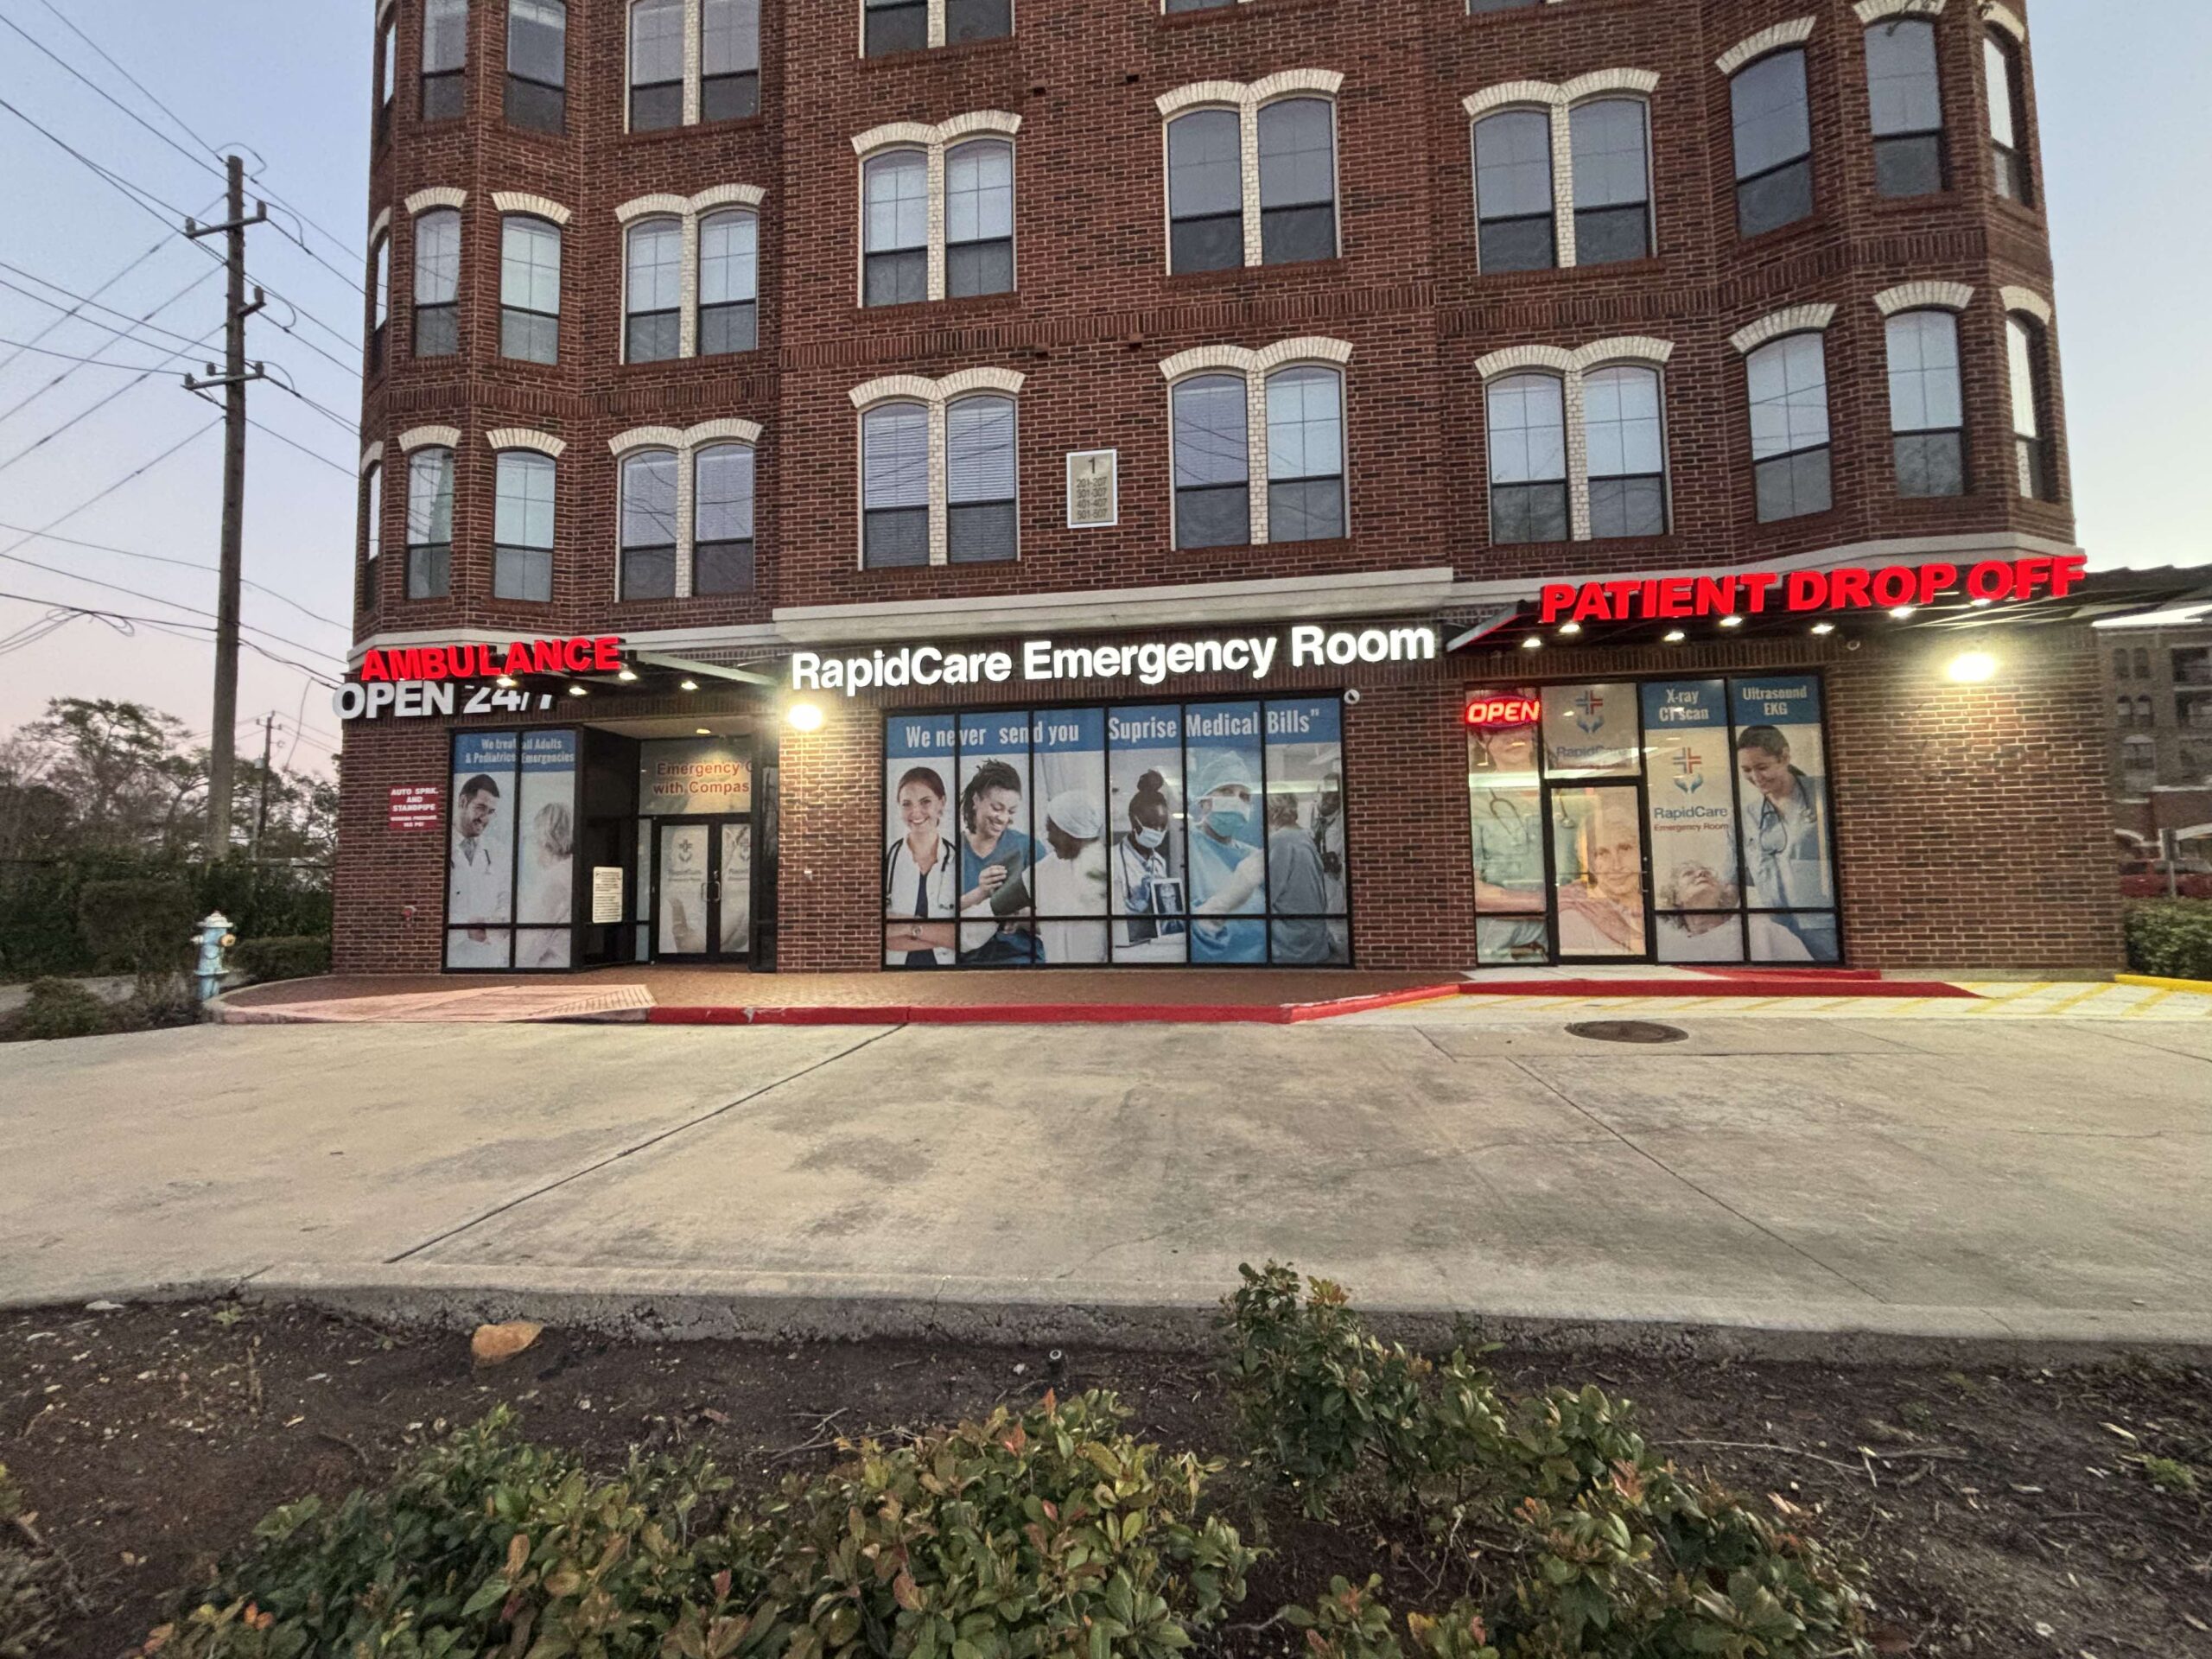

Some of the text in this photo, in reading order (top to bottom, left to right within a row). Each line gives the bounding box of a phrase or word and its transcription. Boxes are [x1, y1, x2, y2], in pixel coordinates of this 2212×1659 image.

[1088, 456, 1095, 474] 1
[1539, 556, 2088, 623] PATIENT DROP OFF
[360, 636, 621, 682] AMBULANCE
[791, 625, 1436, 697] RapidCare Emergency Room
[332, 680, 454, 720] OPEN
[1665, 688, 1700, 704] X-ray
[1743, 686, 1808, 700] Ultrasound
[1467, 701, 1541, 724] OPEN
[1659, 707, 1675, 721] CT
[1764, 702, 1789, 716] EKG
[906, 725, 931, 748] We
[935, 728, 987, 748] never
[999, 721, 1043, 744] send
[1047, 721, 1080, 746] you
[1108, 716, 1178, 743] Suprise
[1185, 712, 1259, 739] Medical
[481, 738, 494, 750] We
[534, 737, 563, 749] Adults
[465, 750, 575, 765] & Pediatrics Emergencies
[657, 761, 741, 778] Emergency
[653, 781, 684, 795] with
[1654, 805, 1728, 821] RapidCare
[1654, 822, 1728, 833] Emergency Room
